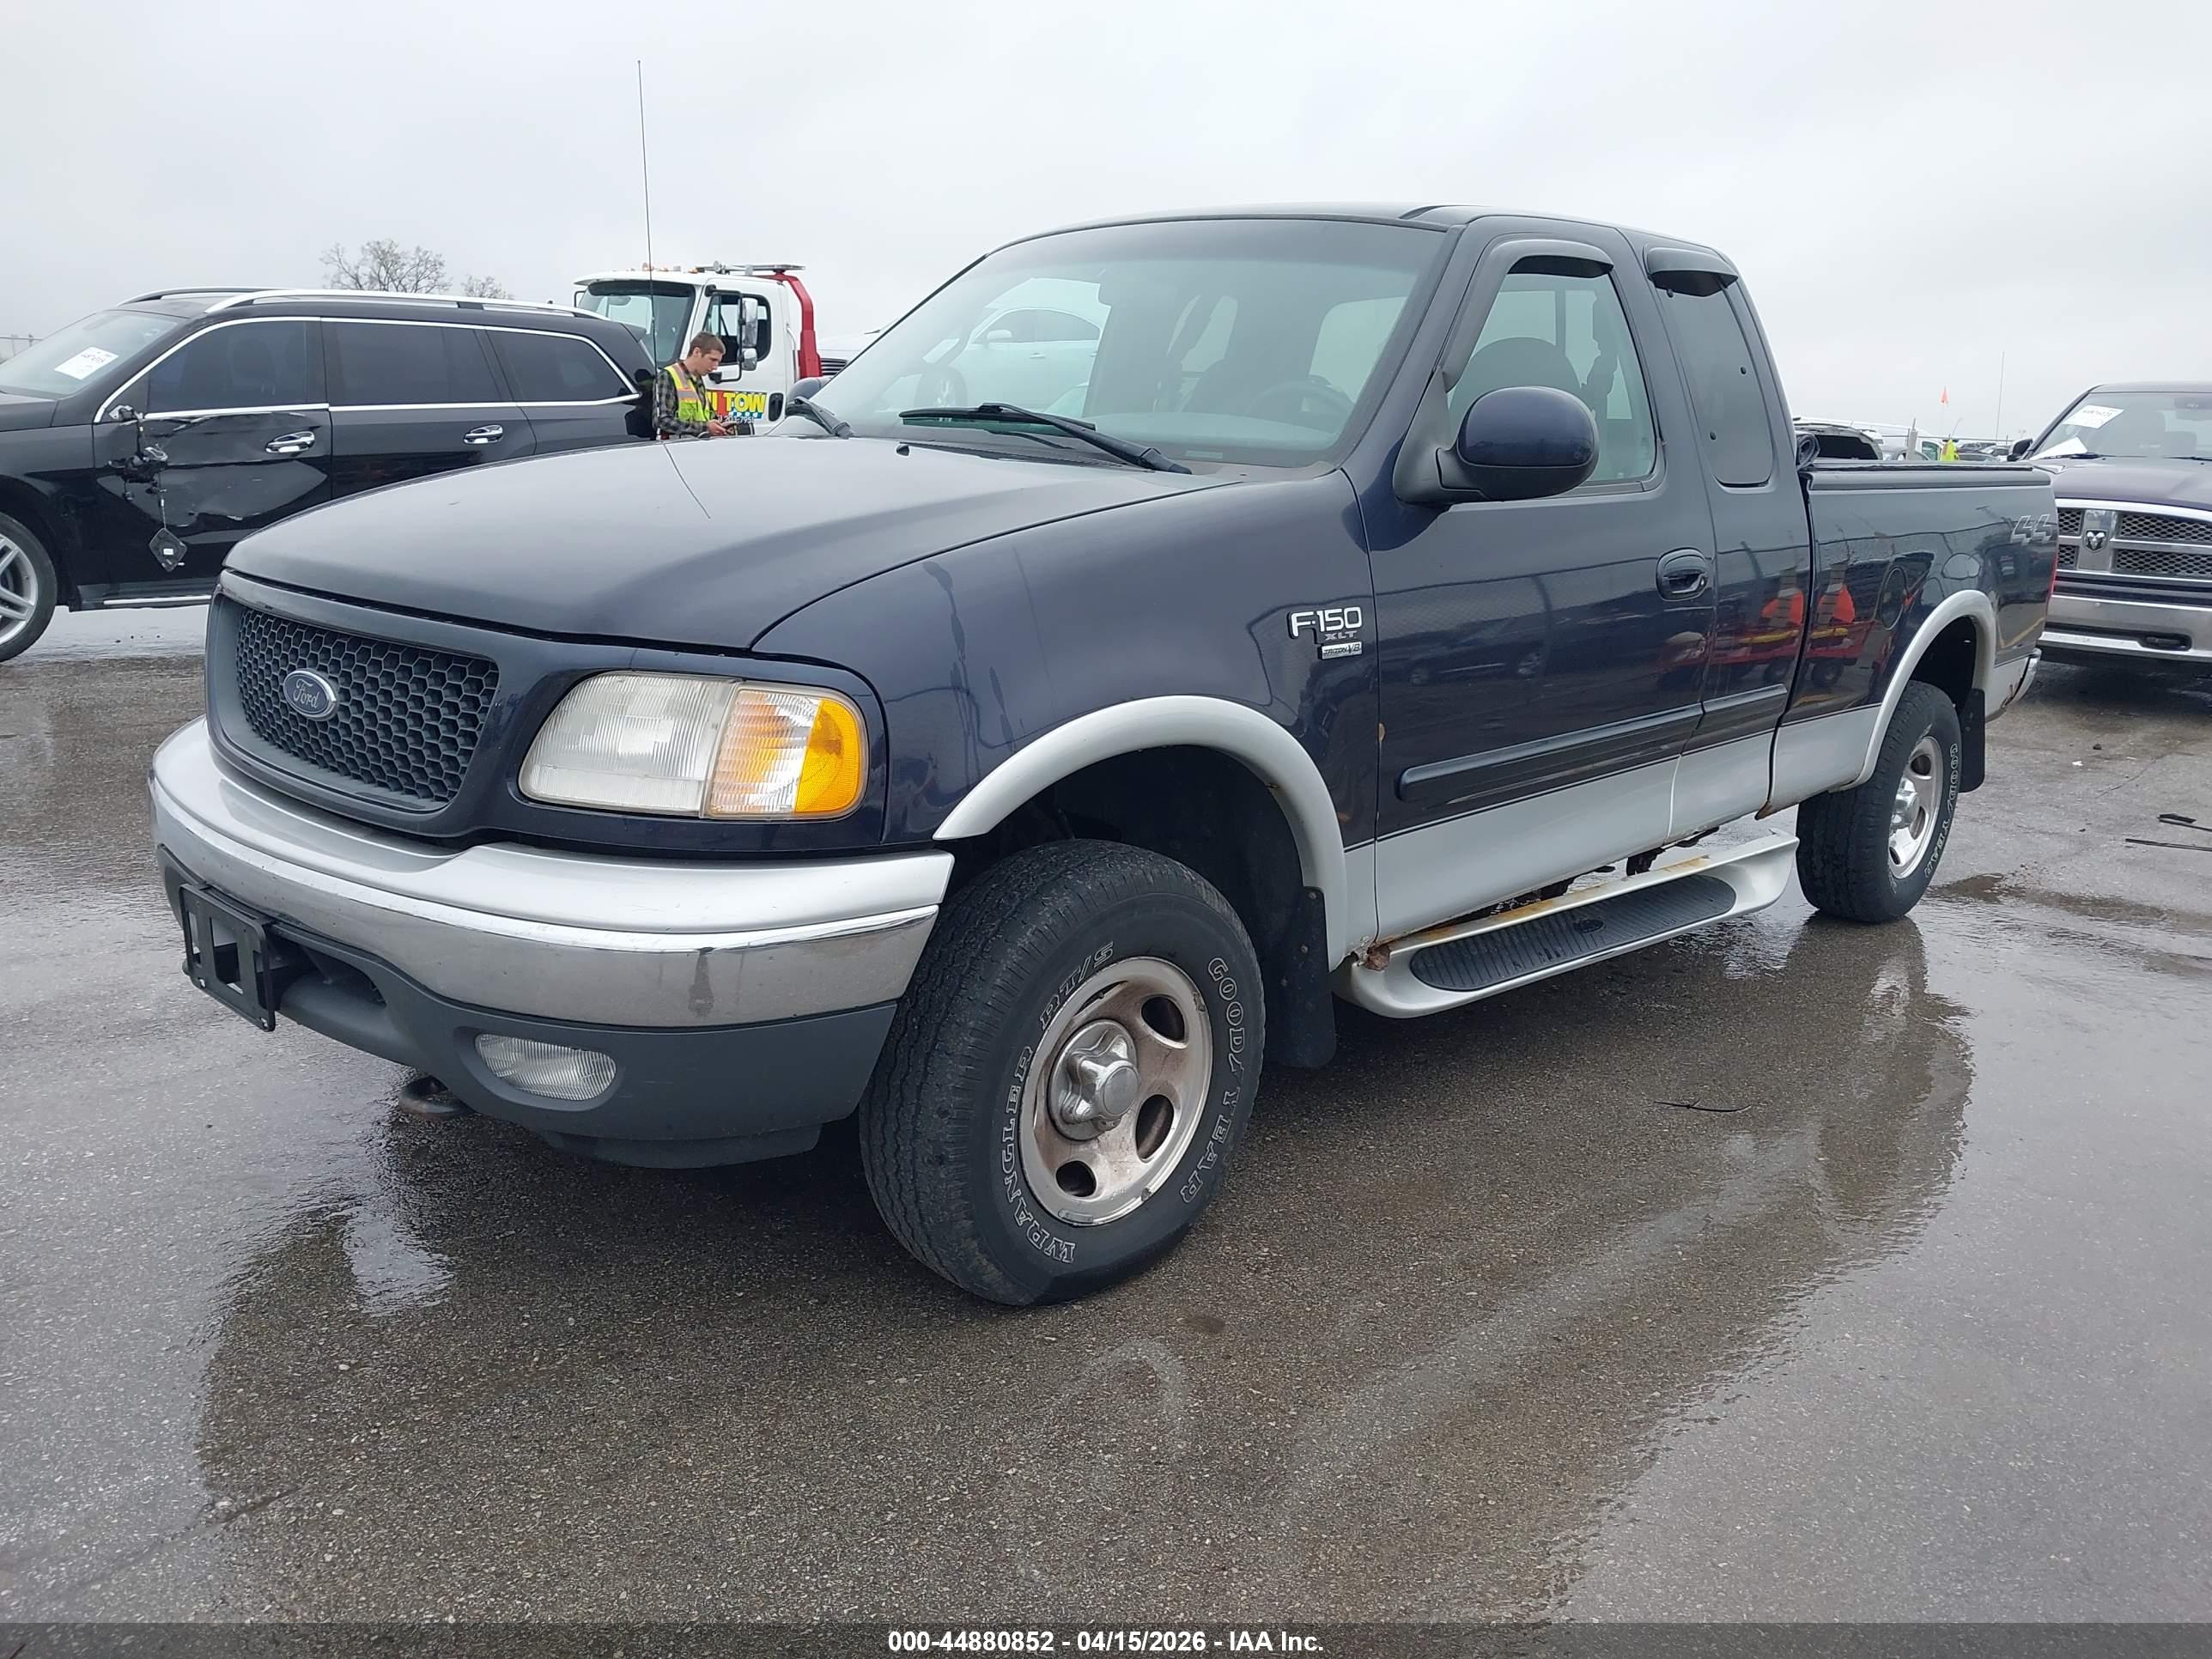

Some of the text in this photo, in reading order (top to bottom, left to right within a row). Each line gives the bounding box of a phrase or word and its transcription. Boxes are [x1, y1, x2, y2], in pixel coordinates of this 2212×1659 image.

[723, 392, 766, 412] TOW
[1291, 606, 1363, 637] F-150
[1324, 629, 1358, 641] XLT
[293, 678, 320, 708] Ford
[1001, 1045, 1076, 1264] WRANGLER
